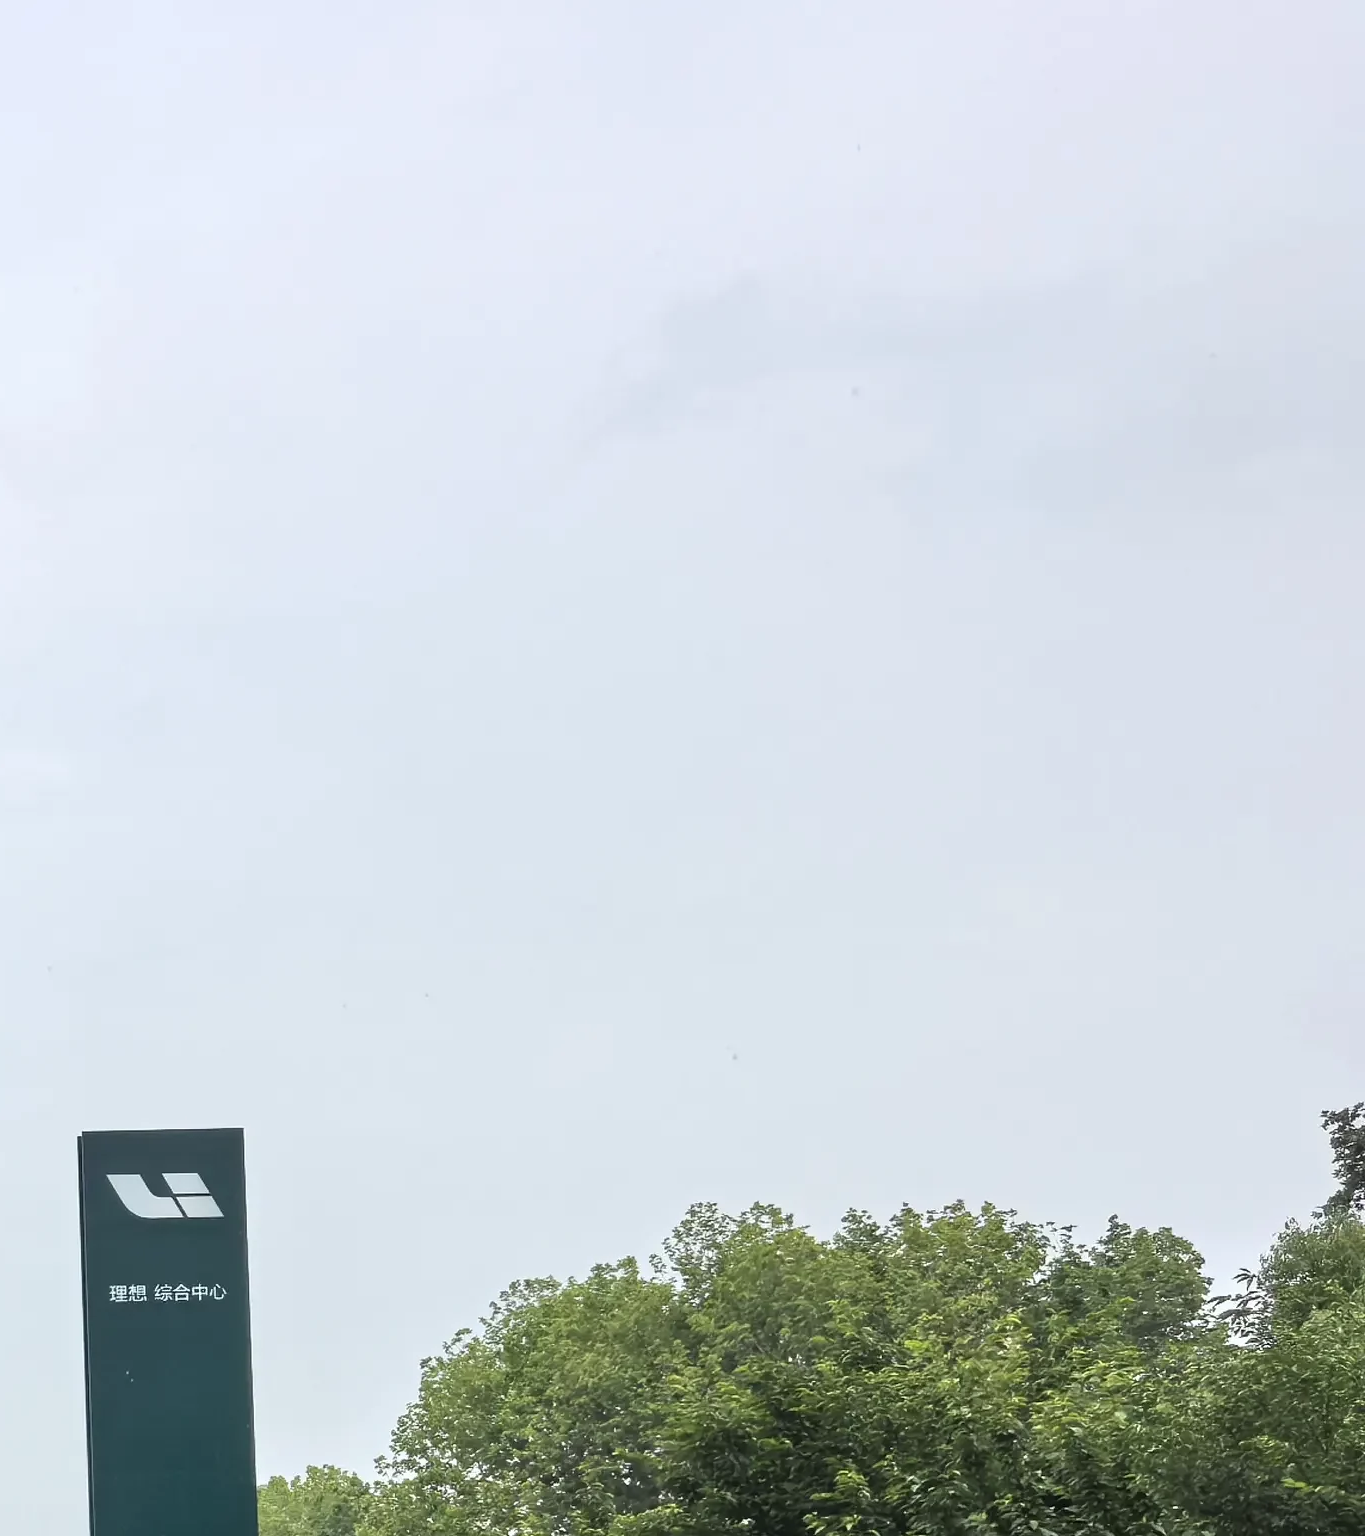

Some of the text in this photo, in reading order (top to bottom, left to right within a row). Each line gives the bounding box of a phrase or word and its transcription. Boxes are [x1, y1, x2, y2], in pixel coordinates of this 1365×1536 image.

[109, 1283, 227, 1302] 理想 综合中心
